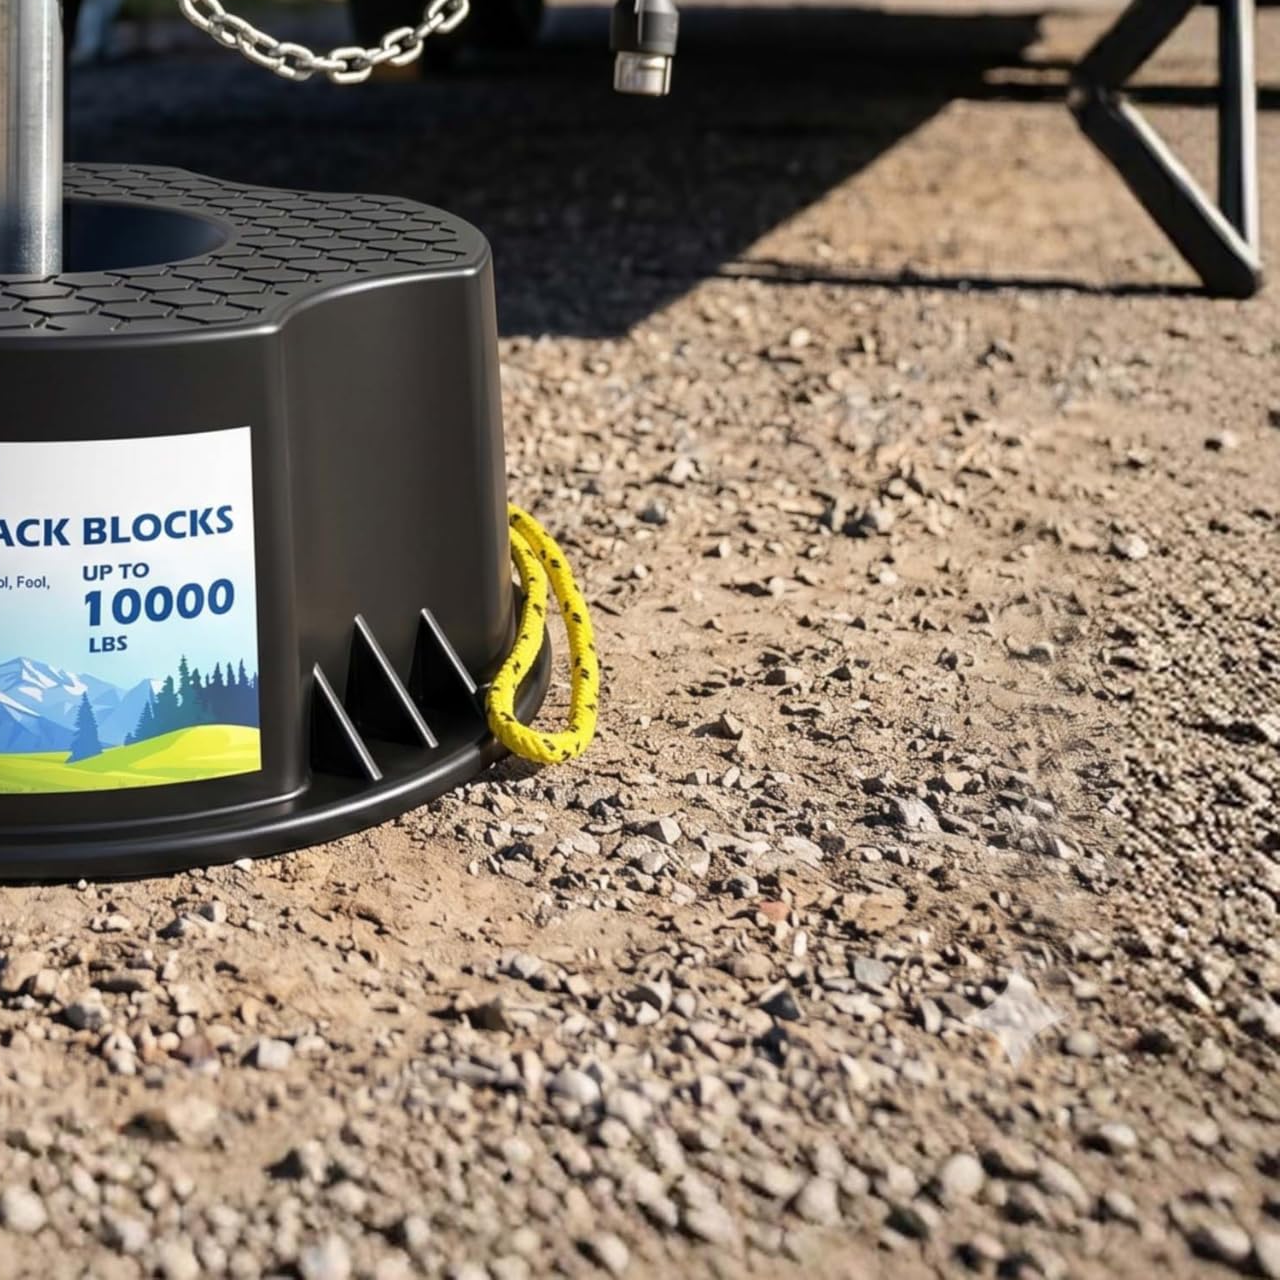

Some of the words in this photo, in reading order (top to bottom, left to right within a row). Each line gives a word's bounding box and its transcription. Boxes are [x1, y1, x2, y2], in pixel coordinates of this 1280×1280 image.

[83, 505, 233, 546] BLOCKS
[83, 564, 113, 581] UP
[118, 562, 150, 580] TO
[84, 578, 235, 627] 10000
[89, 635, 128, 653] LBS
